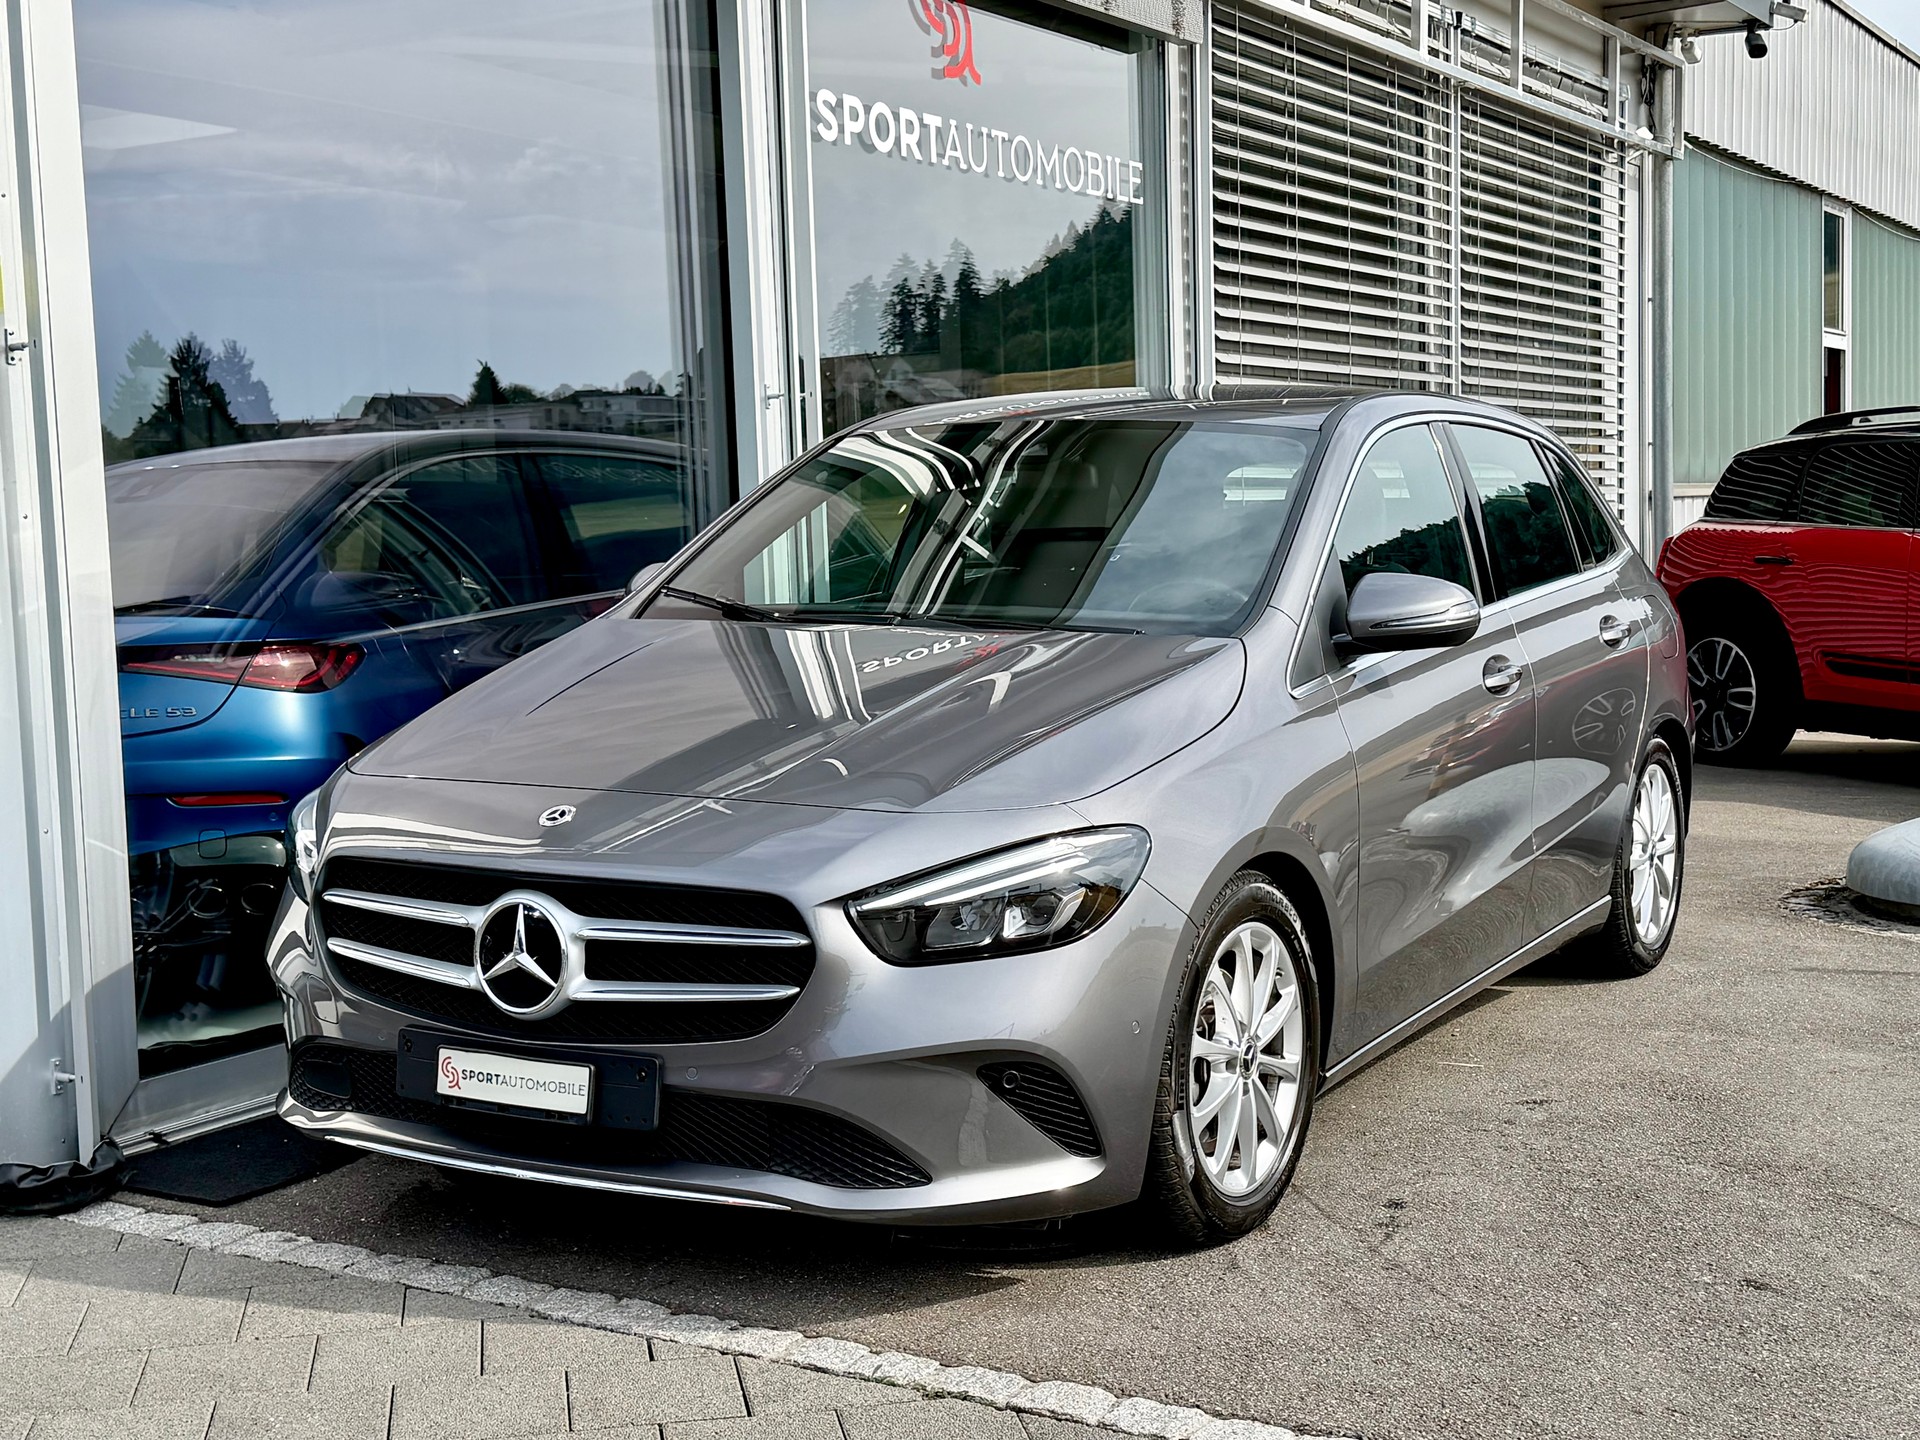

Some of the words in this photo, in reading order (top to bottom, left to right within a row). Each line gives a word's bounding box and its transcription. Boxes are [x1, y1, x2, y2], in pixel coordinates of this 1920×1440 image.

[816, 88, 1144, 205] SPORTAUTOMOBILE
[166, 706, 197, 718] 53
[461, 1069, 586, 1097] SPORTAUTOMOBILE
